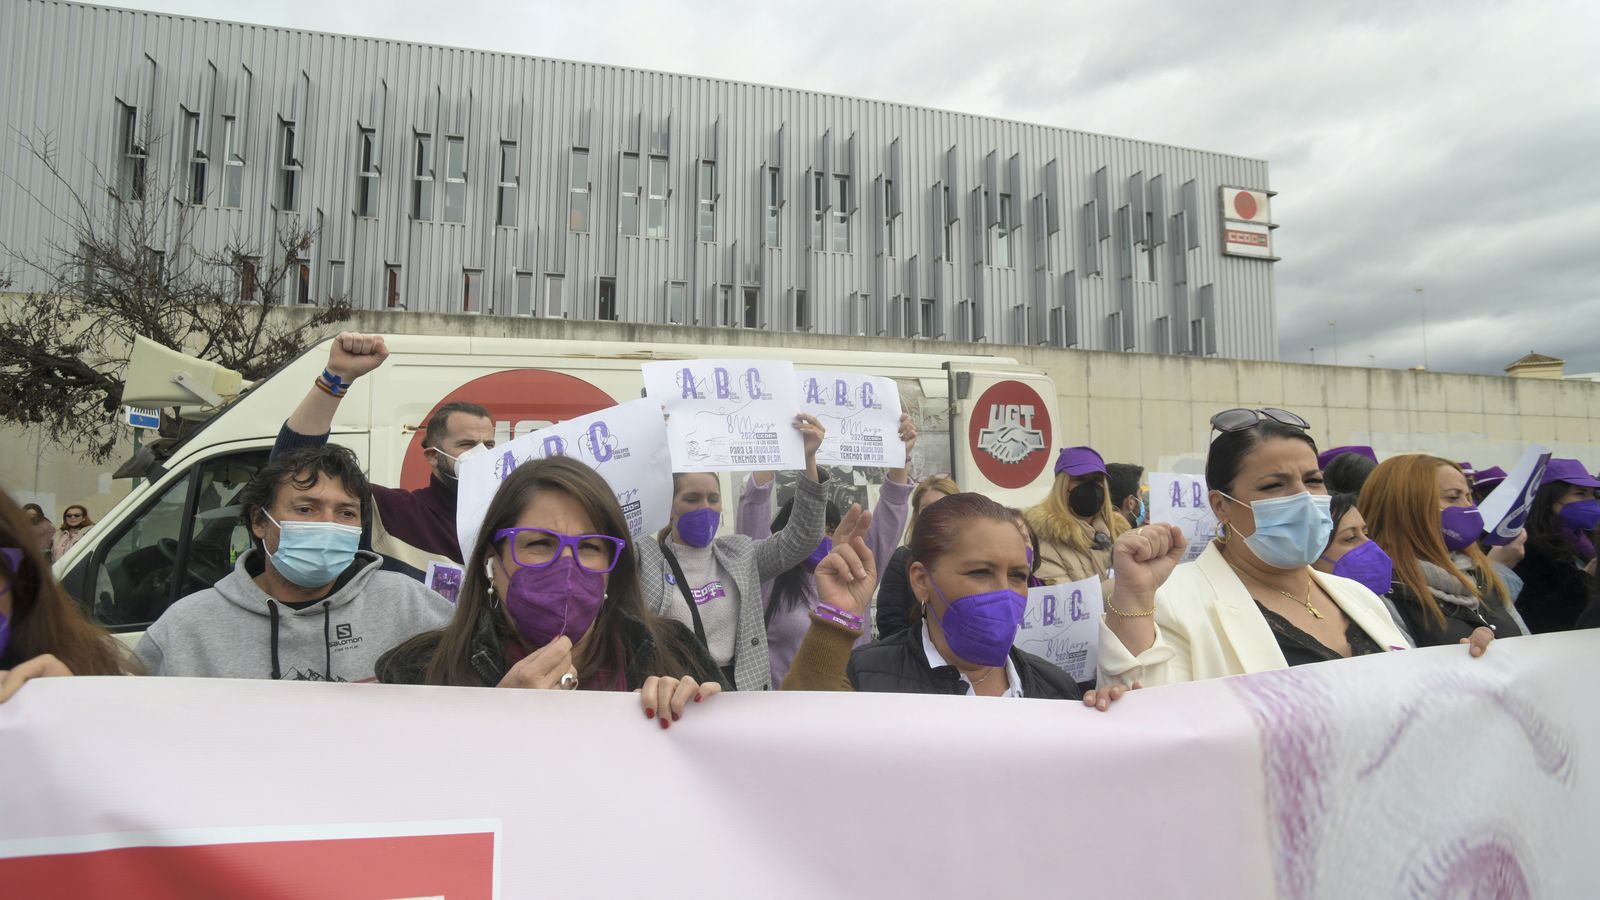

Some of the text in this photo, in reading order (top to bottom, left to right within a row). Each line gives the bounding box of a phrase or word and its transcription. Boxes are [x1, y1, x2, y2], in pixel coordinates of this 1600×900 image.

[682, 367, 762, 400] A B C
[806, 377, 873, 408] A B C
[727, 414, 776, 435] 8 Marzo
[841, 418, 846, 435] 8
[988, 404, 1035, 430] UGT
[589, 421, 613, 462] C
[741, 431, 756, 440] 2022
[730, 445, 780, 455] PARA LA IGUALDAD
[731, 454, 781, 464] TENEMOS UN PLAN
[853, 445, 860, 453] LA
[1171, 481, 1201, 508] A B
[1043, 589, 1082, 627] B C
